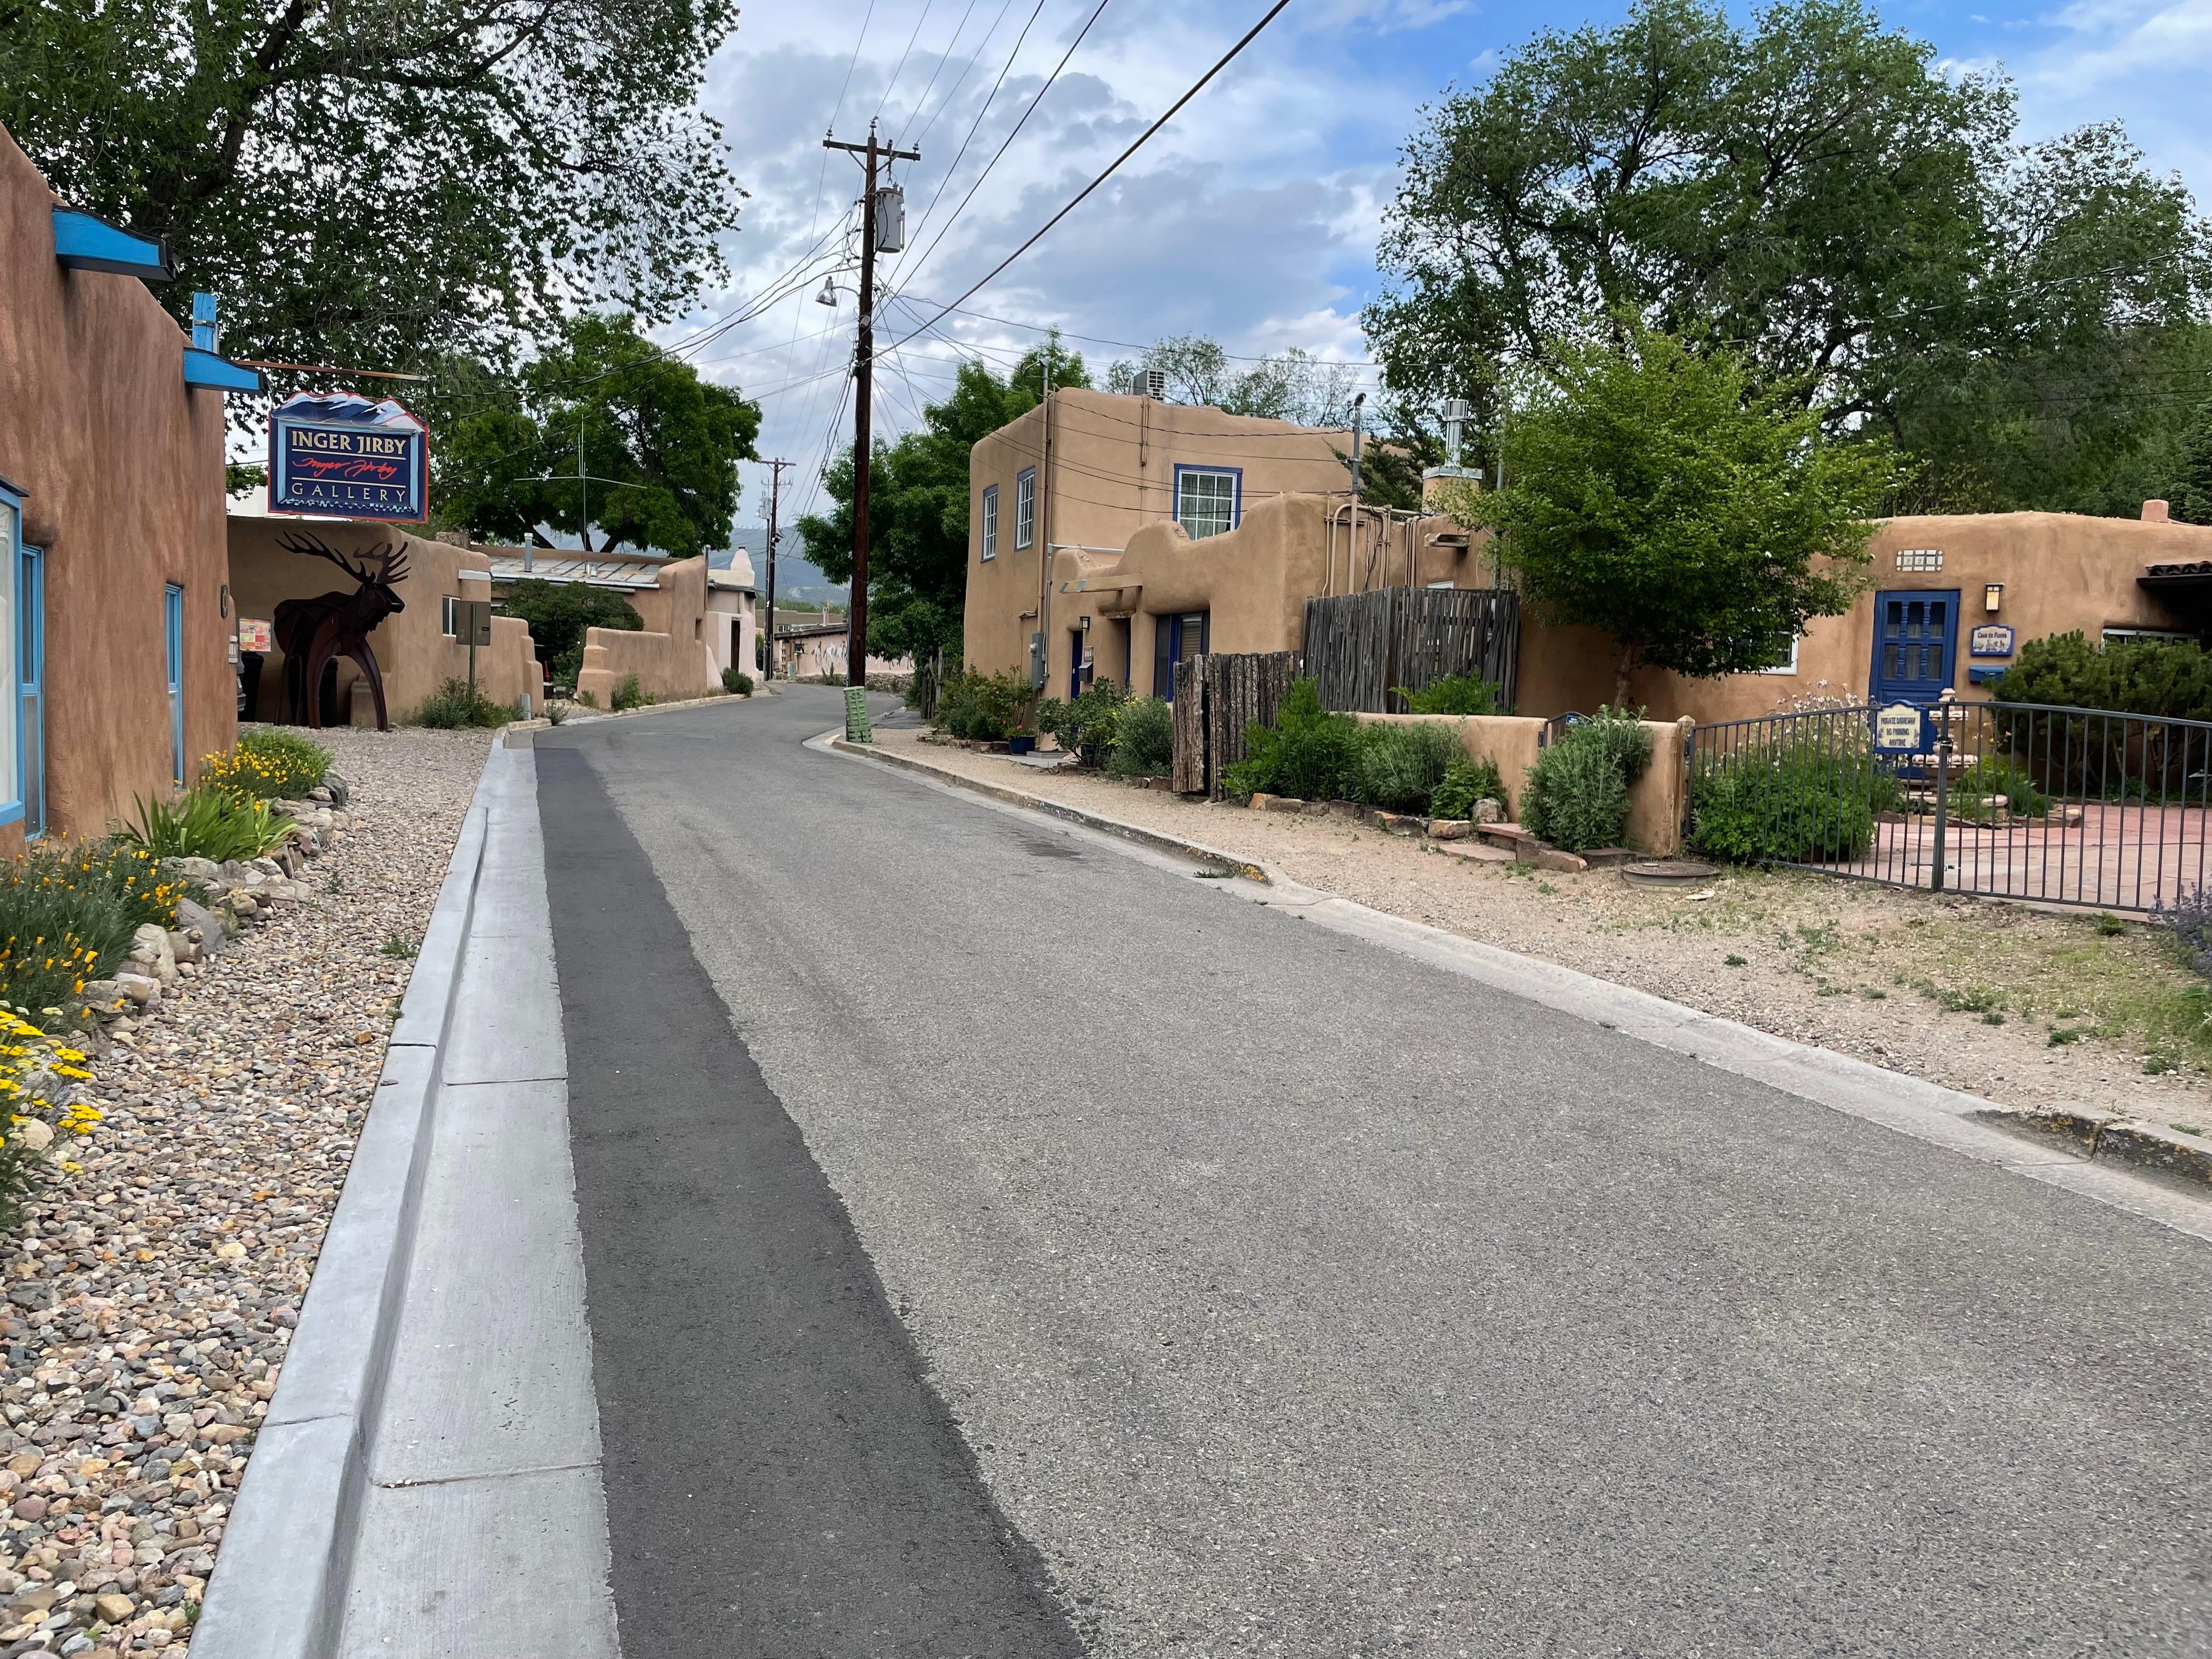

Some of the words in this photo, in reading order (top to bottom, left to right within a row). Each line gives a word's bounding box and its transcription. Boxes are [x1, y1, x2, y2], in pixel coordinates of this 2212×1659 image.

[292, 431, 352, 450] INGER
[357, 436, 406, 454] JIRBY
[292, 458, 351, 477] Inger
[344, 459, 397, 480] Jirby
[291, 482, 405, 502] GALLERY
[1889, 738, 1906, 747] ANYTIME
